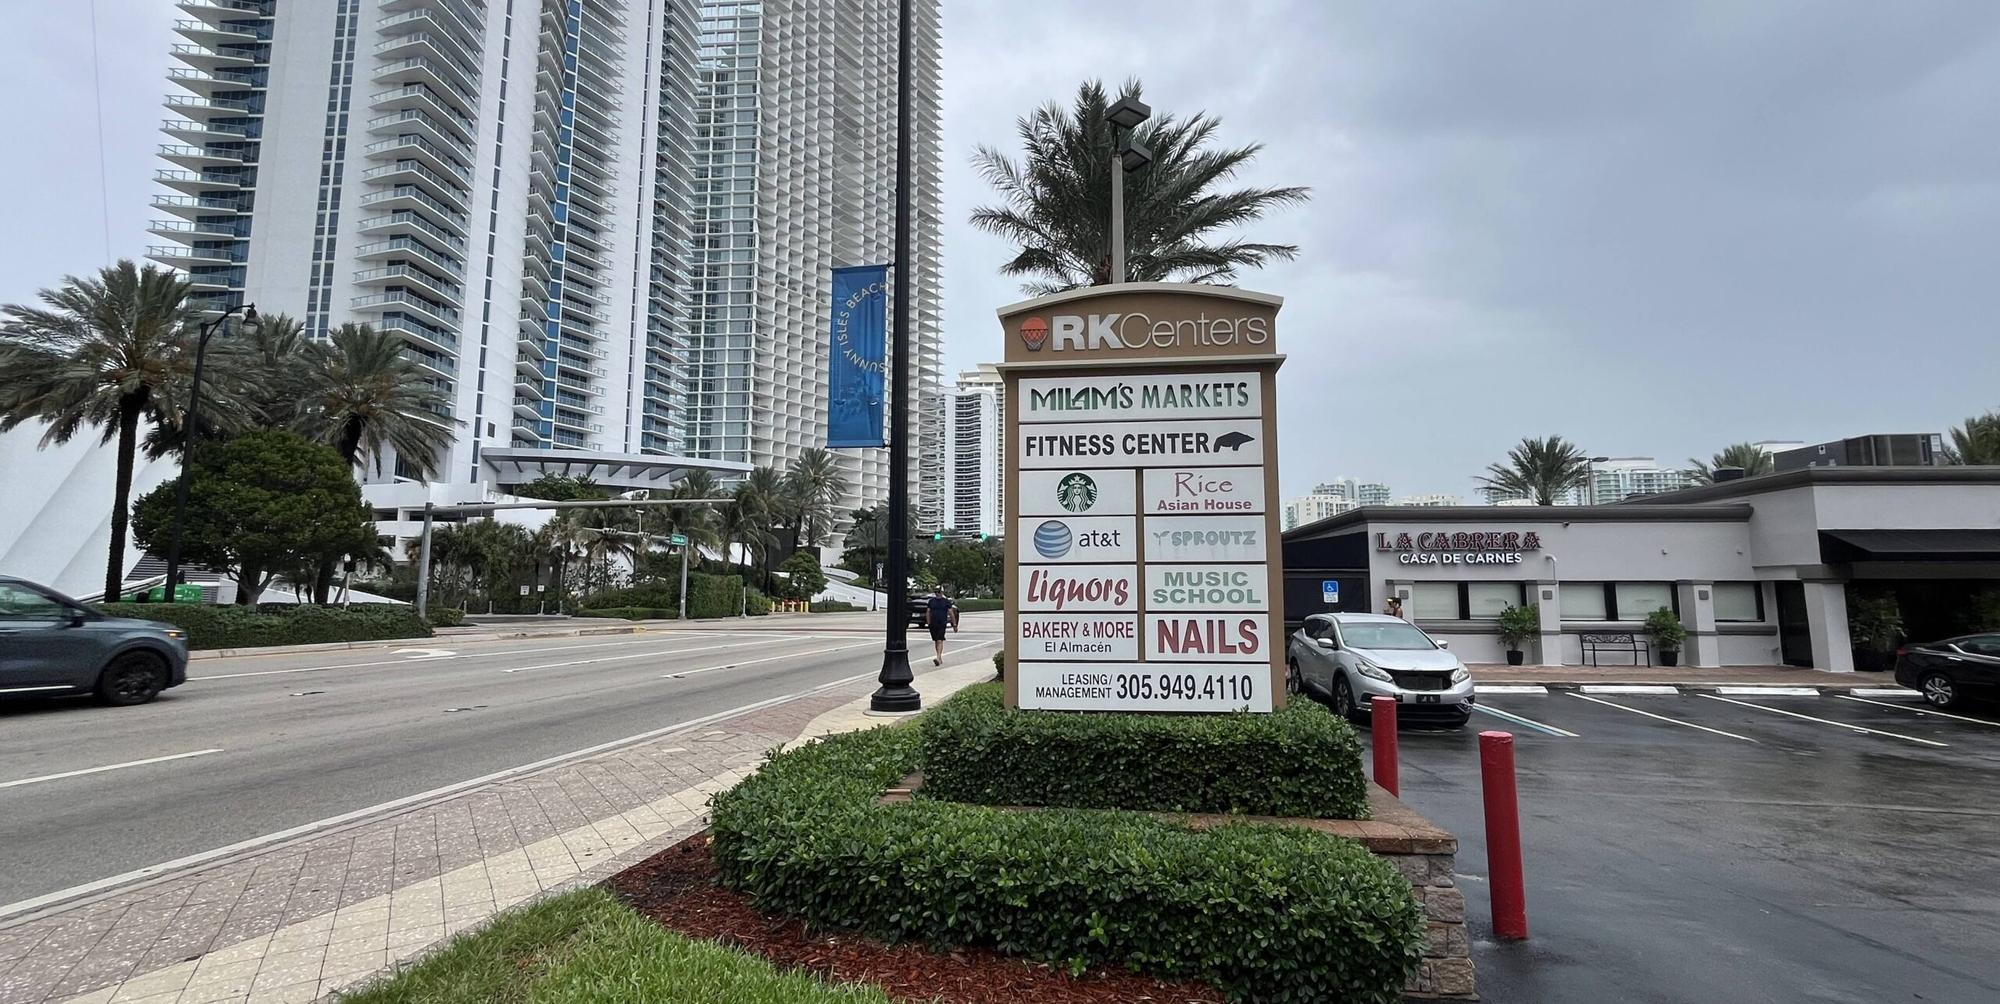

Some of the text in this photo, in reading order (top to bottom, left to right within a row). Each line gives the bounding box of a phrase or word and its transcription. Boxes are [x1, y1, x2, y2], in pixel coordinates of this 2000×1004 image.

[837, 283, 887, 373] SUNNY ISLES BEACH
[1030, 382, 1249, 411] MILAM'S MARKETS
[1026, 432, 1209, 457] FITNESS CENTER
[1174, 472, 1234, 497] Rice
[1157, 499, 1252, 511] Asian House
[1078, 529, 1121, 547] at&t
[1171, 530, 1256, 546] SPROUTZ
[1417, 532, 1543, 551] CABRERA
[1400, 552, 1522, 563] CASA DE CARNES
[1164, 571, 1249, 587] MUSIC
[1027, 570, 1129, 611] Liquors
[1152, 589, 1261, 604] SCHOOL
[1022, 621, 1134, 638] BAKERY & MORE
[1157, 619, 1259, 654] NAILS
[1045, 641, 1112, 653] El Almacén
[1062, 673, 1113, 685] LEASING/
[1116, 674, 1253, 700] 305.949.4110
[1035, 687, 1112, 698] MANAGEMENT
